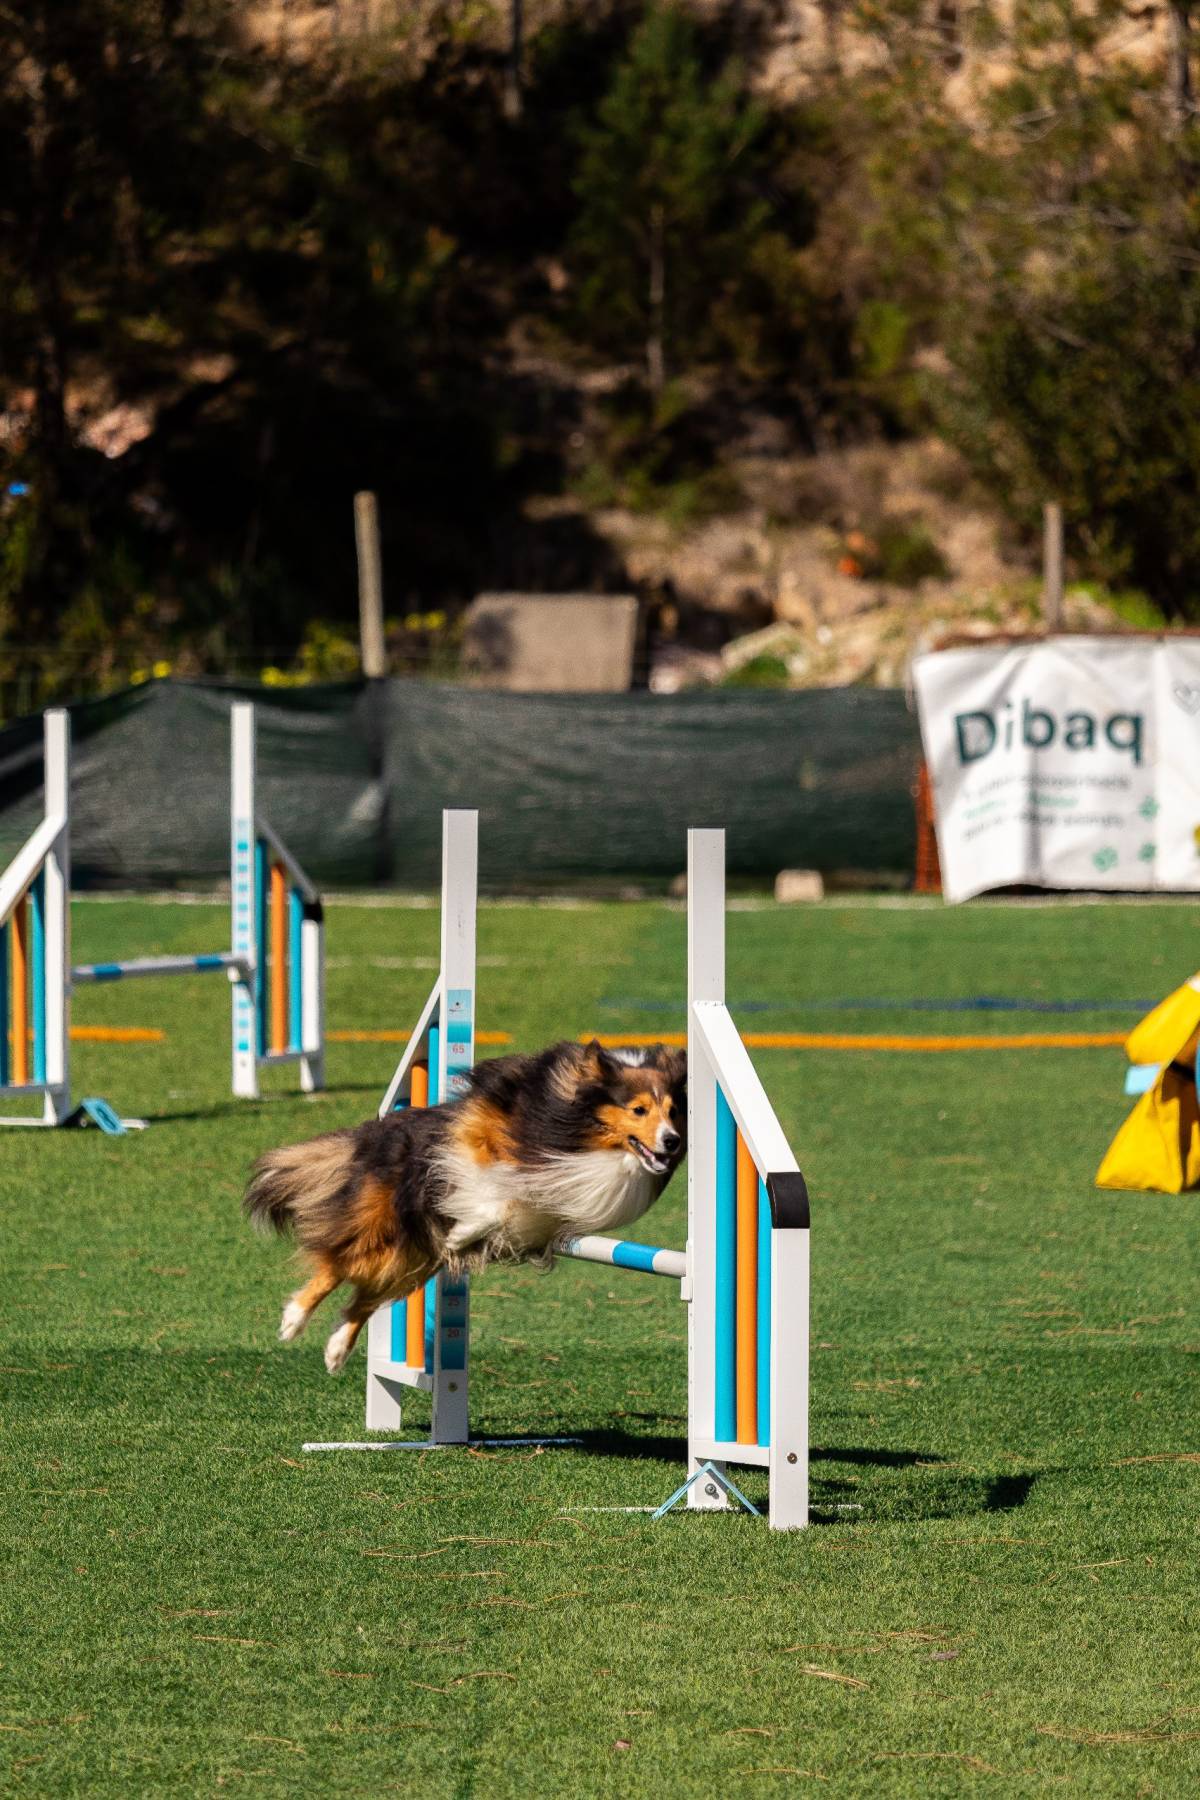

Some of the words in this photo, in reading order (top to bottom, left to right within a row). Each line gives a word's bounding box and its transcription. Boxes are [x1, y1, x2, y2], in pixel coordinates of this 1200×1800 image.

[955, 698, 1143, 766] Dibaq
[452, 1044, 464, 1053] 65
[448, 1328, 459, 1337] 20
